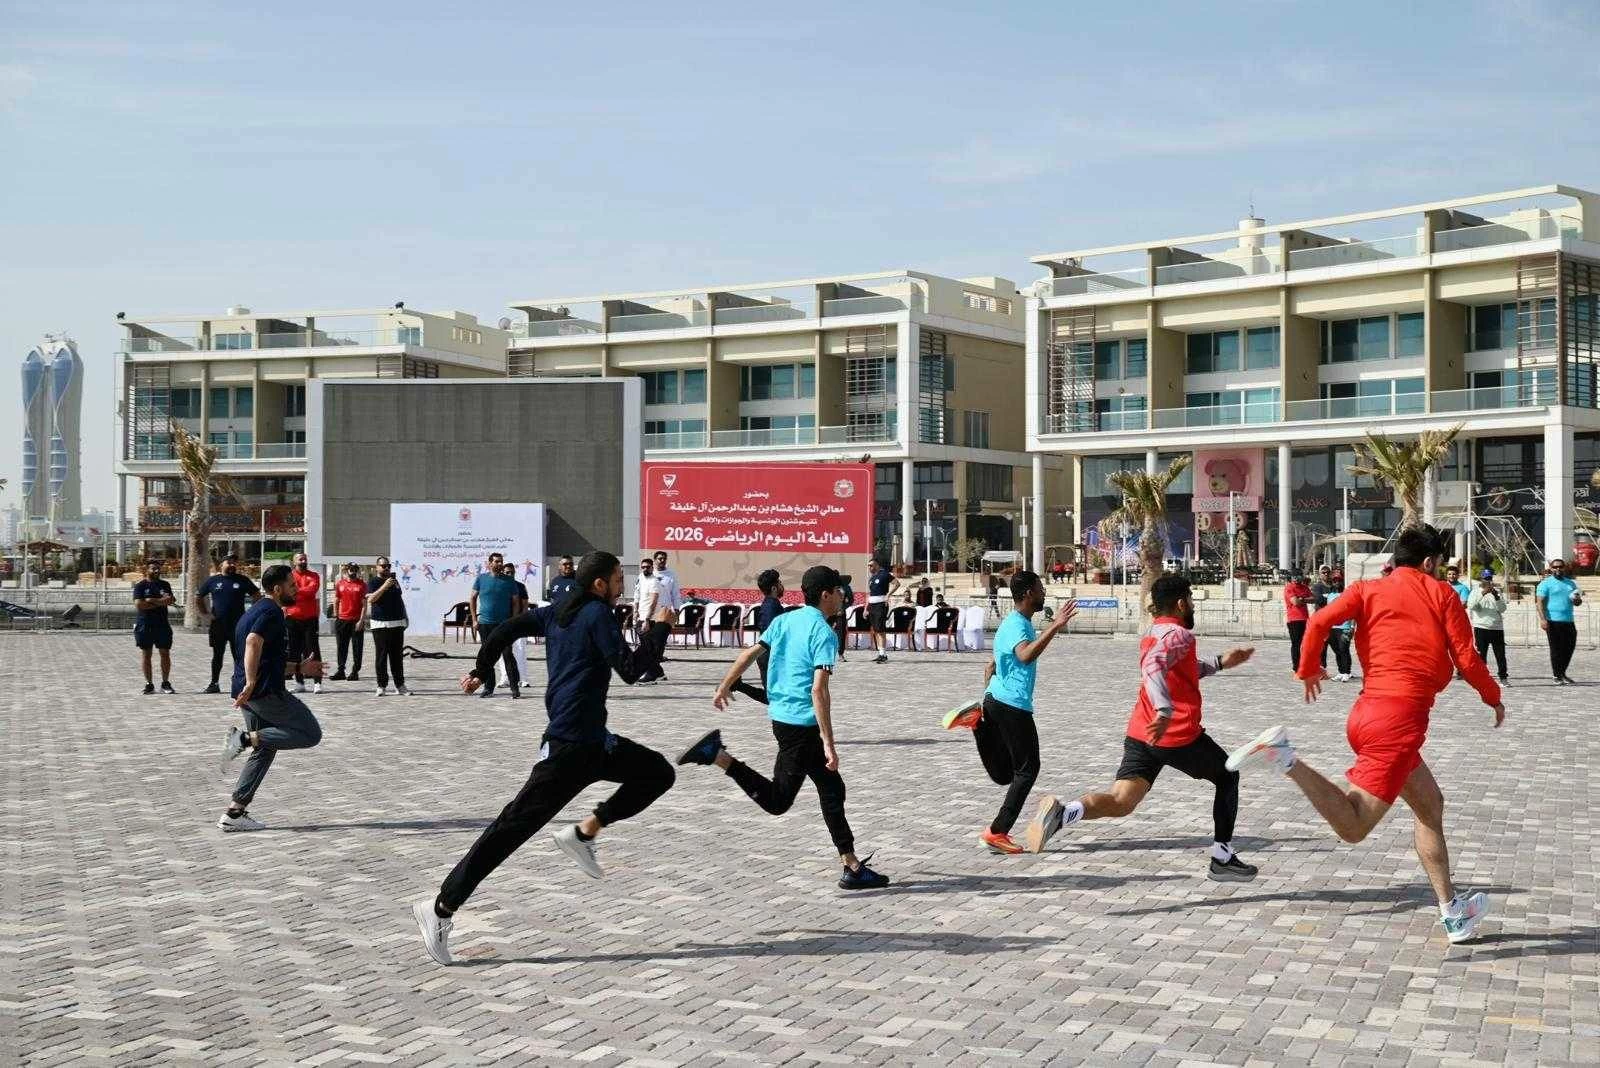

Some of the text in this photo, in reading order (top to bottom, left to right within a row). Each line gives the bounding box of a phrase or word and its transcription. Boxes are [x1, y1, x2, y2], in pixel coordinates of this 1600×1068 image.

[743, 490, 768, 498] بحضور
[670, 502, 697, 512] خليفة
[698, 502, 708, 512] آل
[758, 504, 770, 514] بن
[770, 504, 794, 514] هشام
[794, 503, 819, 516] الشيخ
[820, 504, 844, 516] معالي
[664, 526, 849, 546] فعالية اليوم الرياضي 2026
